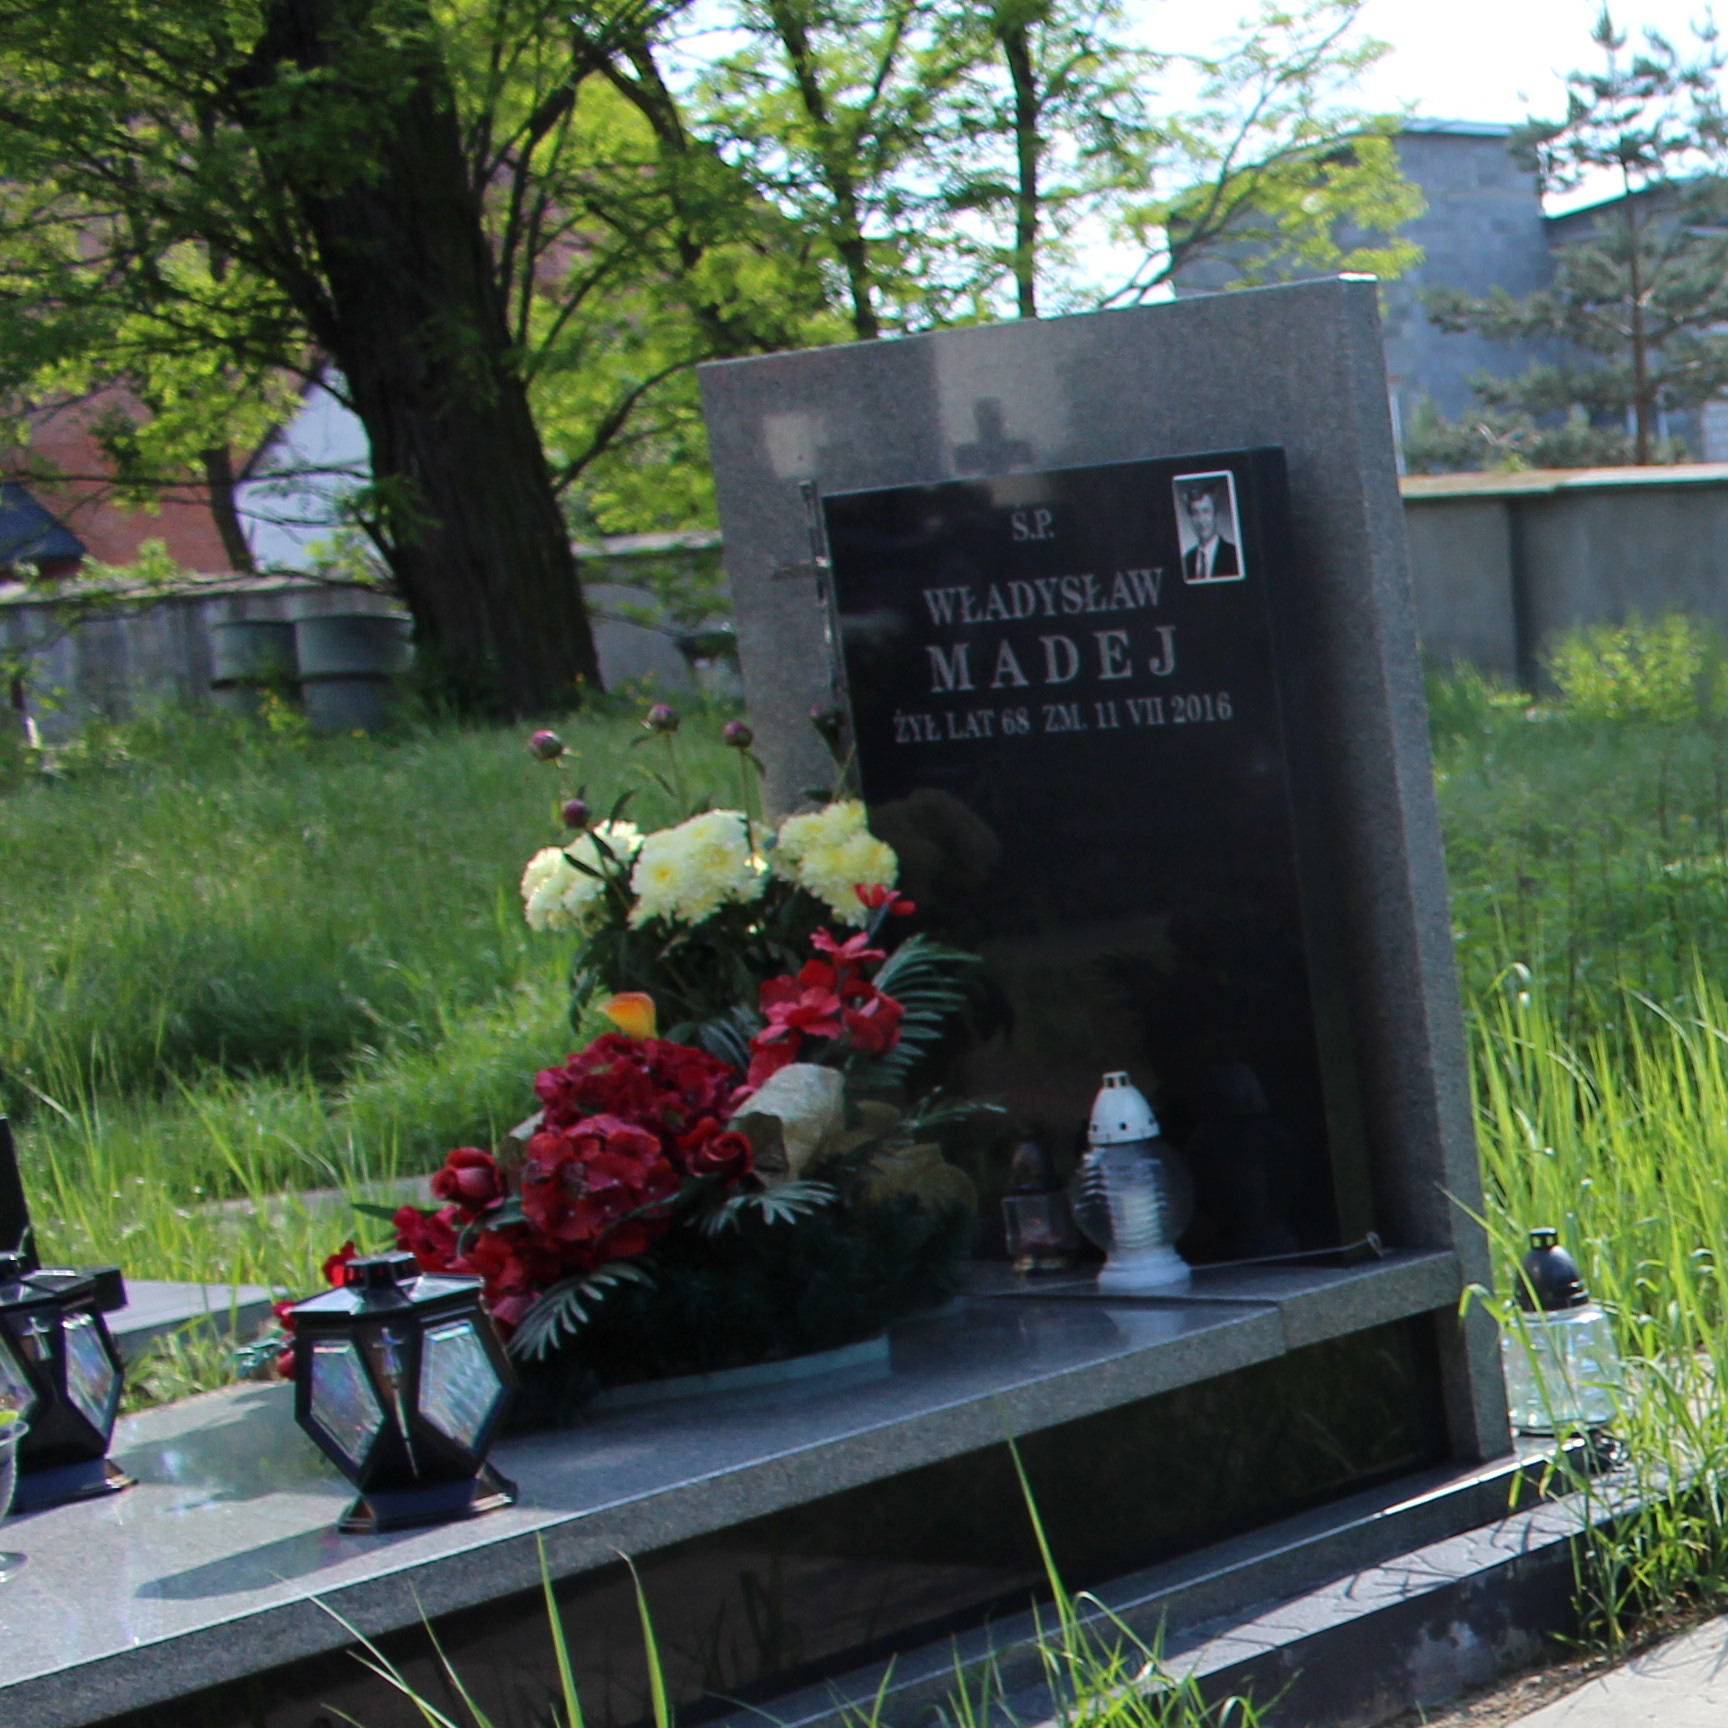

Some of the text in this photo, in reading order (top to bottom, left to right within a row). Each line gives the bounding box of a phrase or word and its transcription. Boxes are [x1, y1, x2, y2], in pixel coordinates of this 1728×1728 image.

[923, 567, 1163, 627] WŁADYSŁAW
[892, 690, 1234, 744] ŻYŁ LAT 68 ZM. 11 VII 2016
